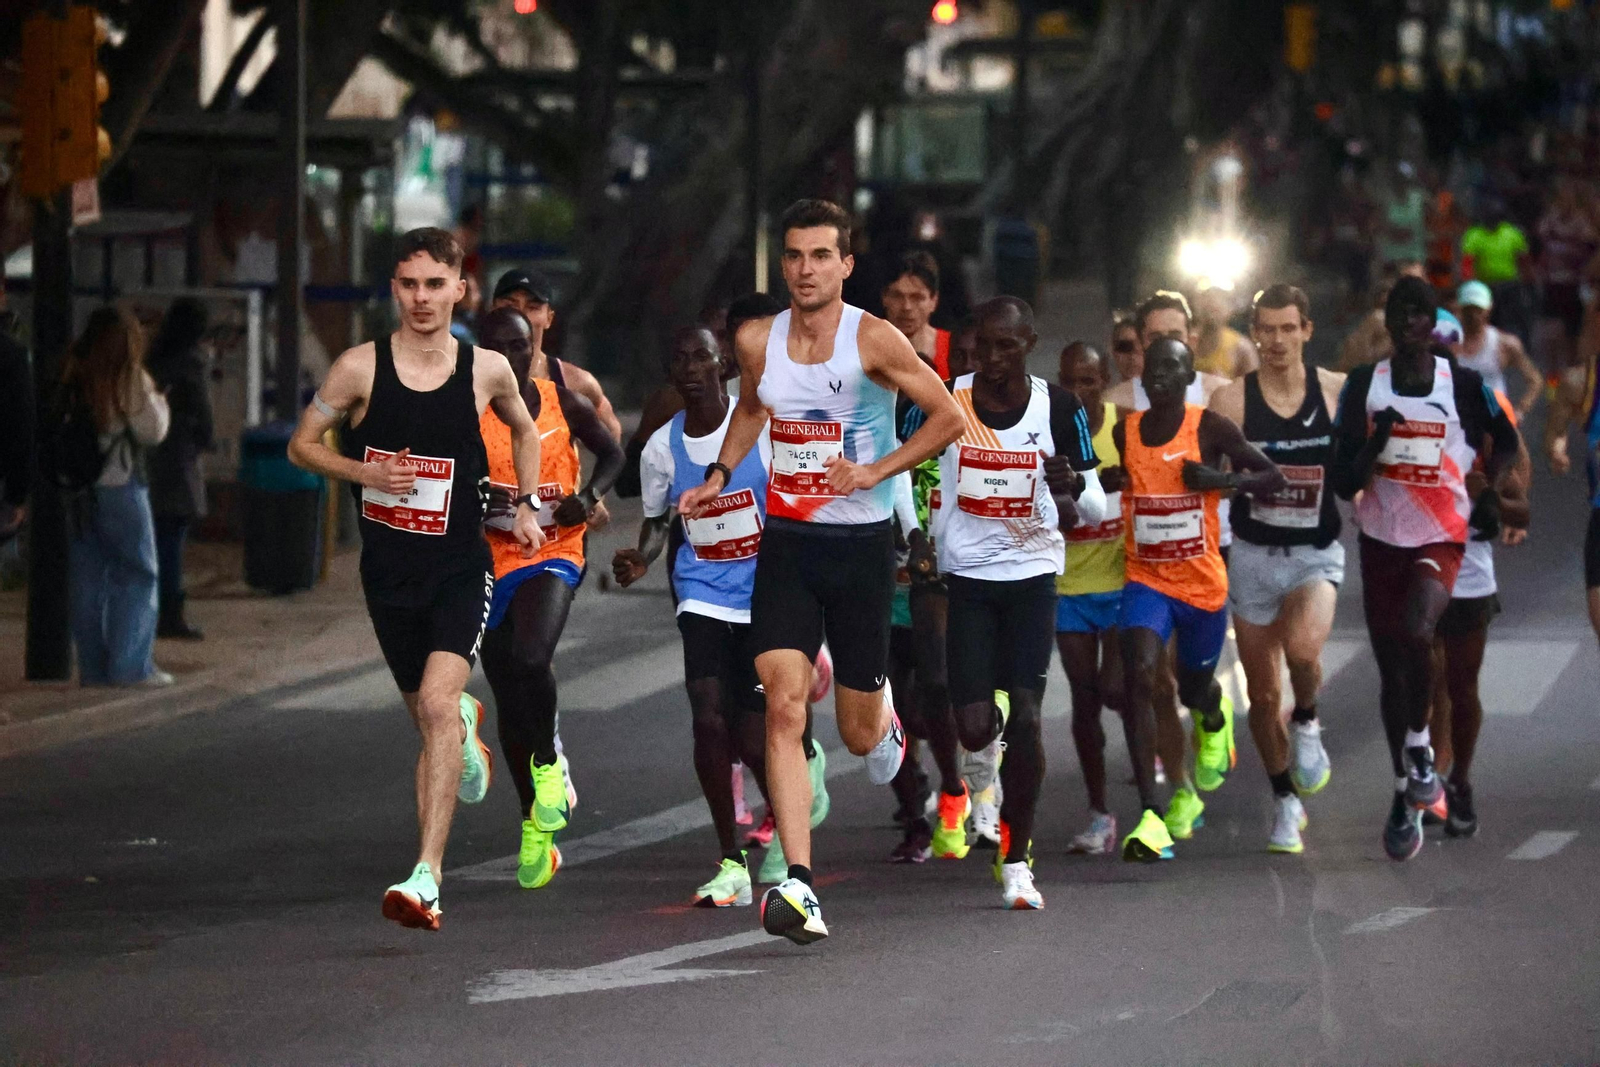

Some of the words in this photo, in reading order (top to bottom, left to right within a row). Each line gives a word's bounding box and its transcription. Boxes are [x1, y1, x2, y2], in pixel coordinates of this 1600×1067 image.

[782, 423, 836, 436] GENERALI
[788, 450, 819, 460] PACER
[980, 451, 1033, 465] GENERALI
[984, 477, 1008, 486] KIGEN
[705, 493, 748, 511] ENERALI
[715, 522, 725, 530] 37
